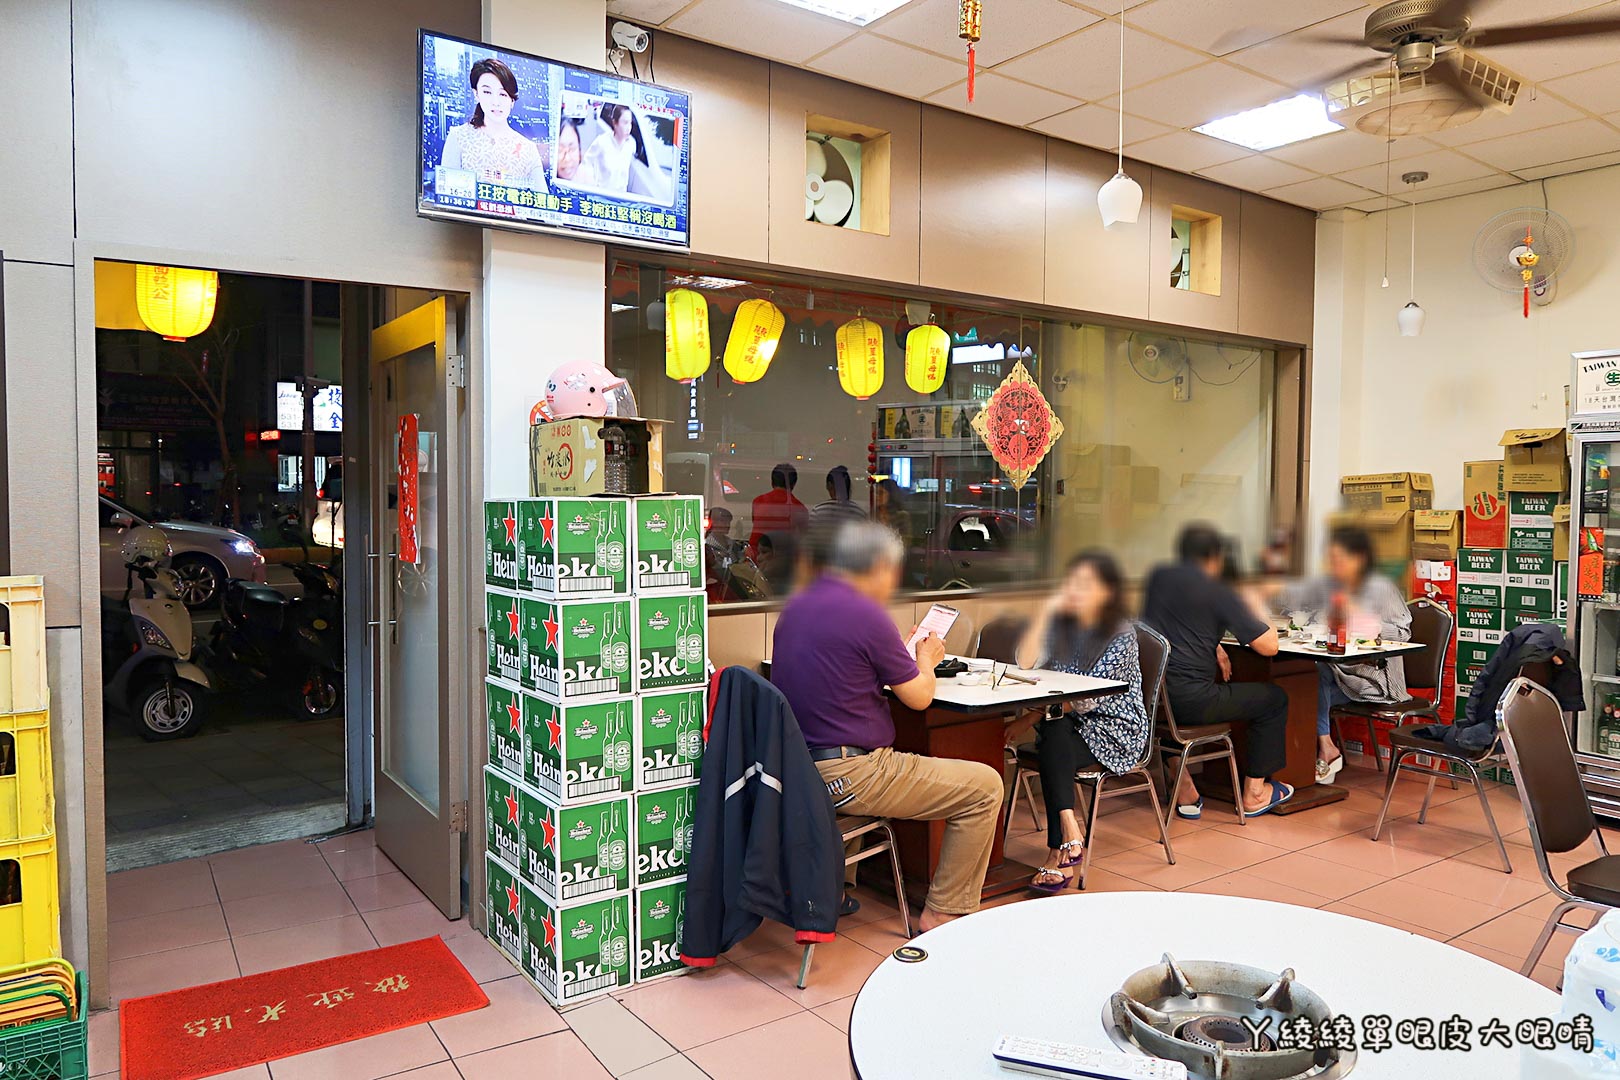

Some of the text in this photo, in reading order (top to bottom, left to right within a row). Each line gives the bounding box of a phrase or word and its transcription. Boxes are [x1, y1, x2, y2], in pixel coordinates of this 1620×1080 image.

[1583, 361, 1617, 373] TAIWAN
[1519, 563, 1541, 571] BEER
[1470, 618, 1490, 626] BEER
